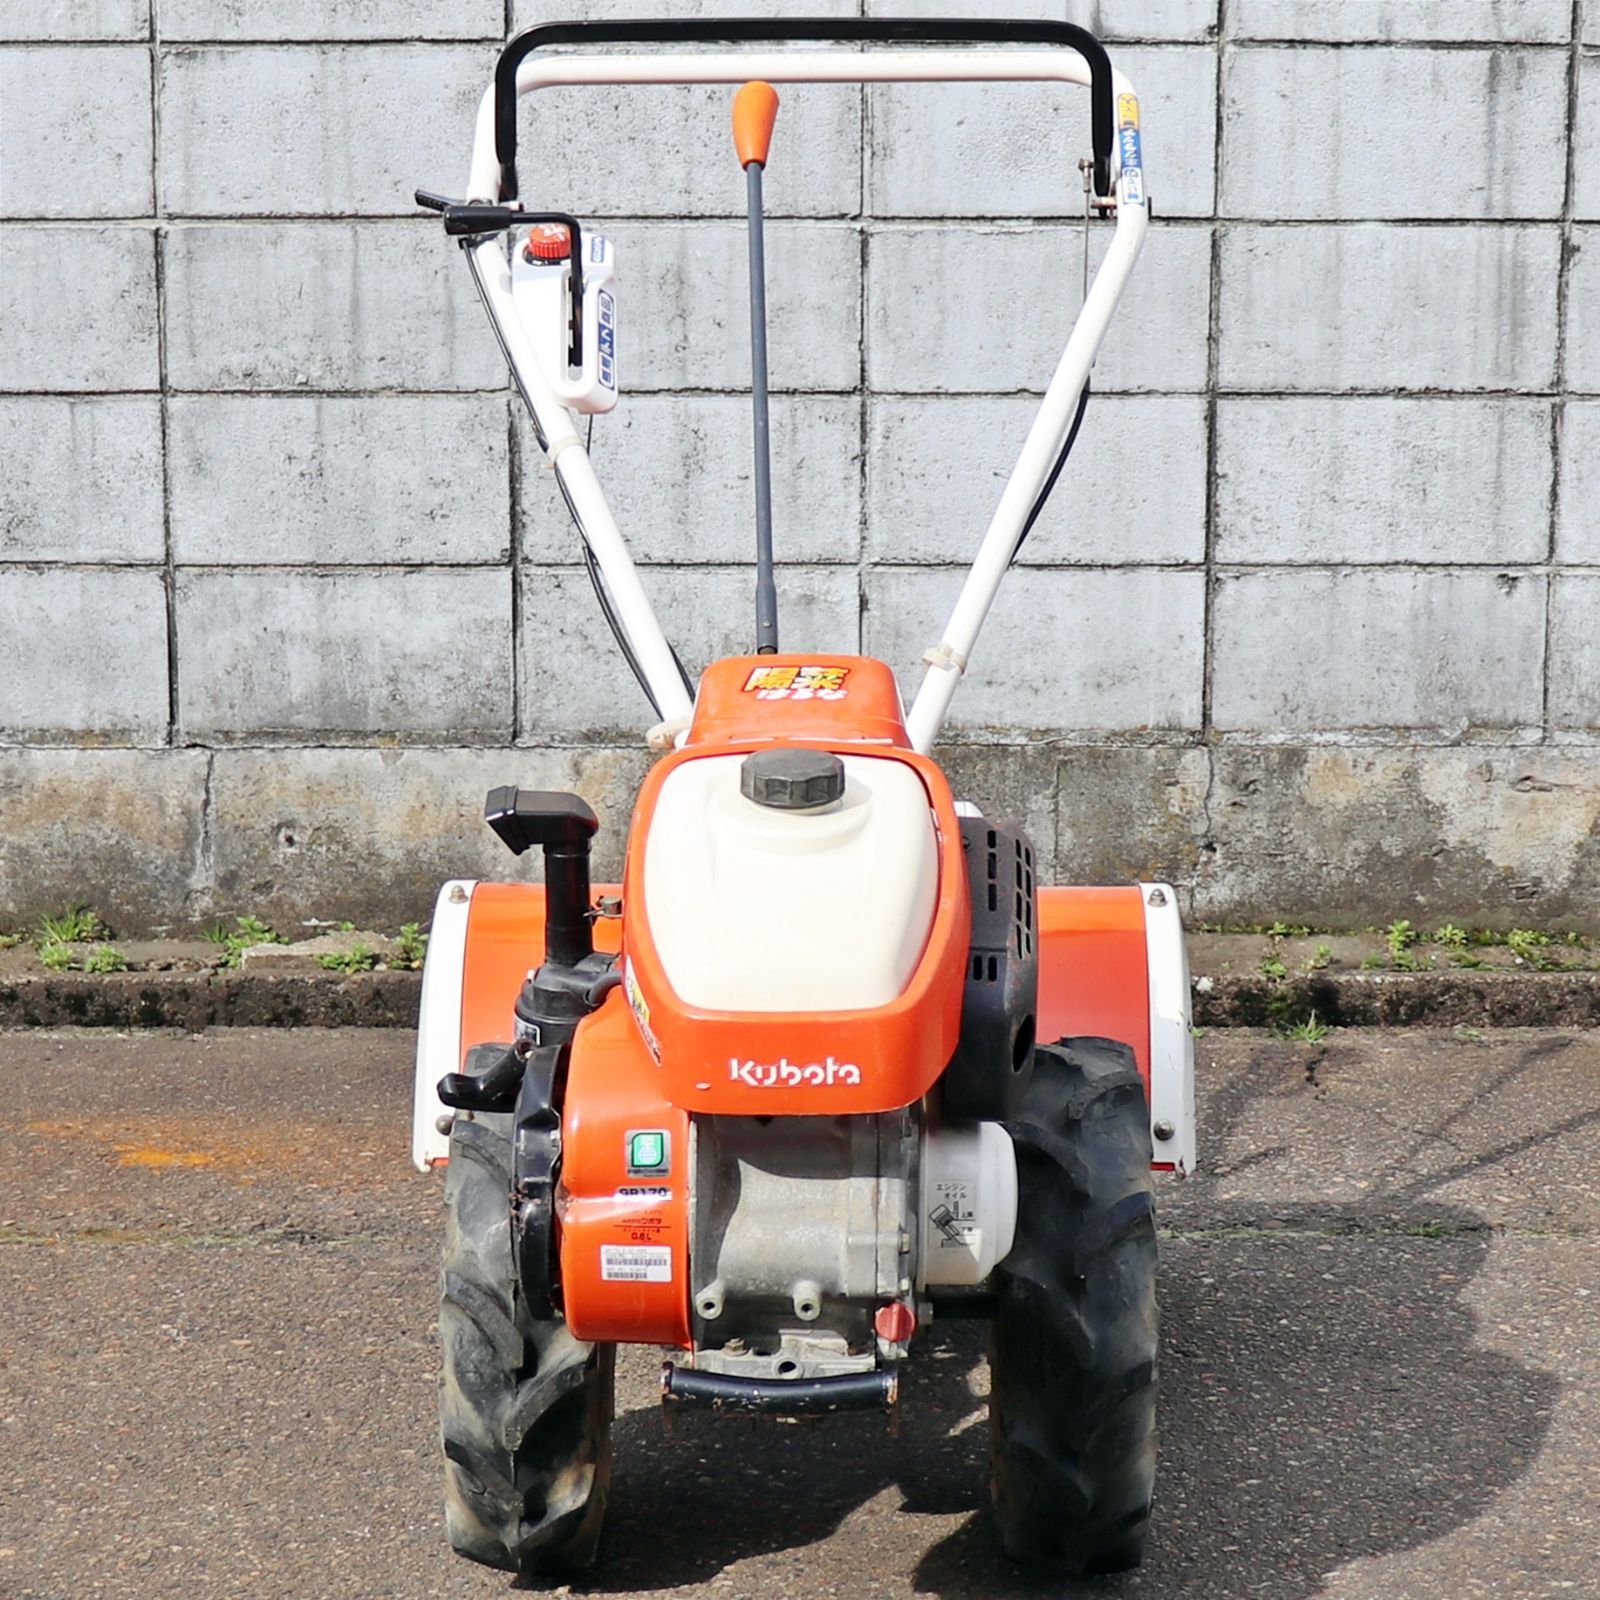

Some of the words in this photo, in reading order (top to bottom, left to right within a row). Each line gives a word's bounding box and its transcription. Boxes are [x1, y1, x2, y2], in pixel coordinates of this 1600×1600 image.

[729, 1056, 861, 1086] Kubota
[936, 1183, 967, 1191] エンジン
